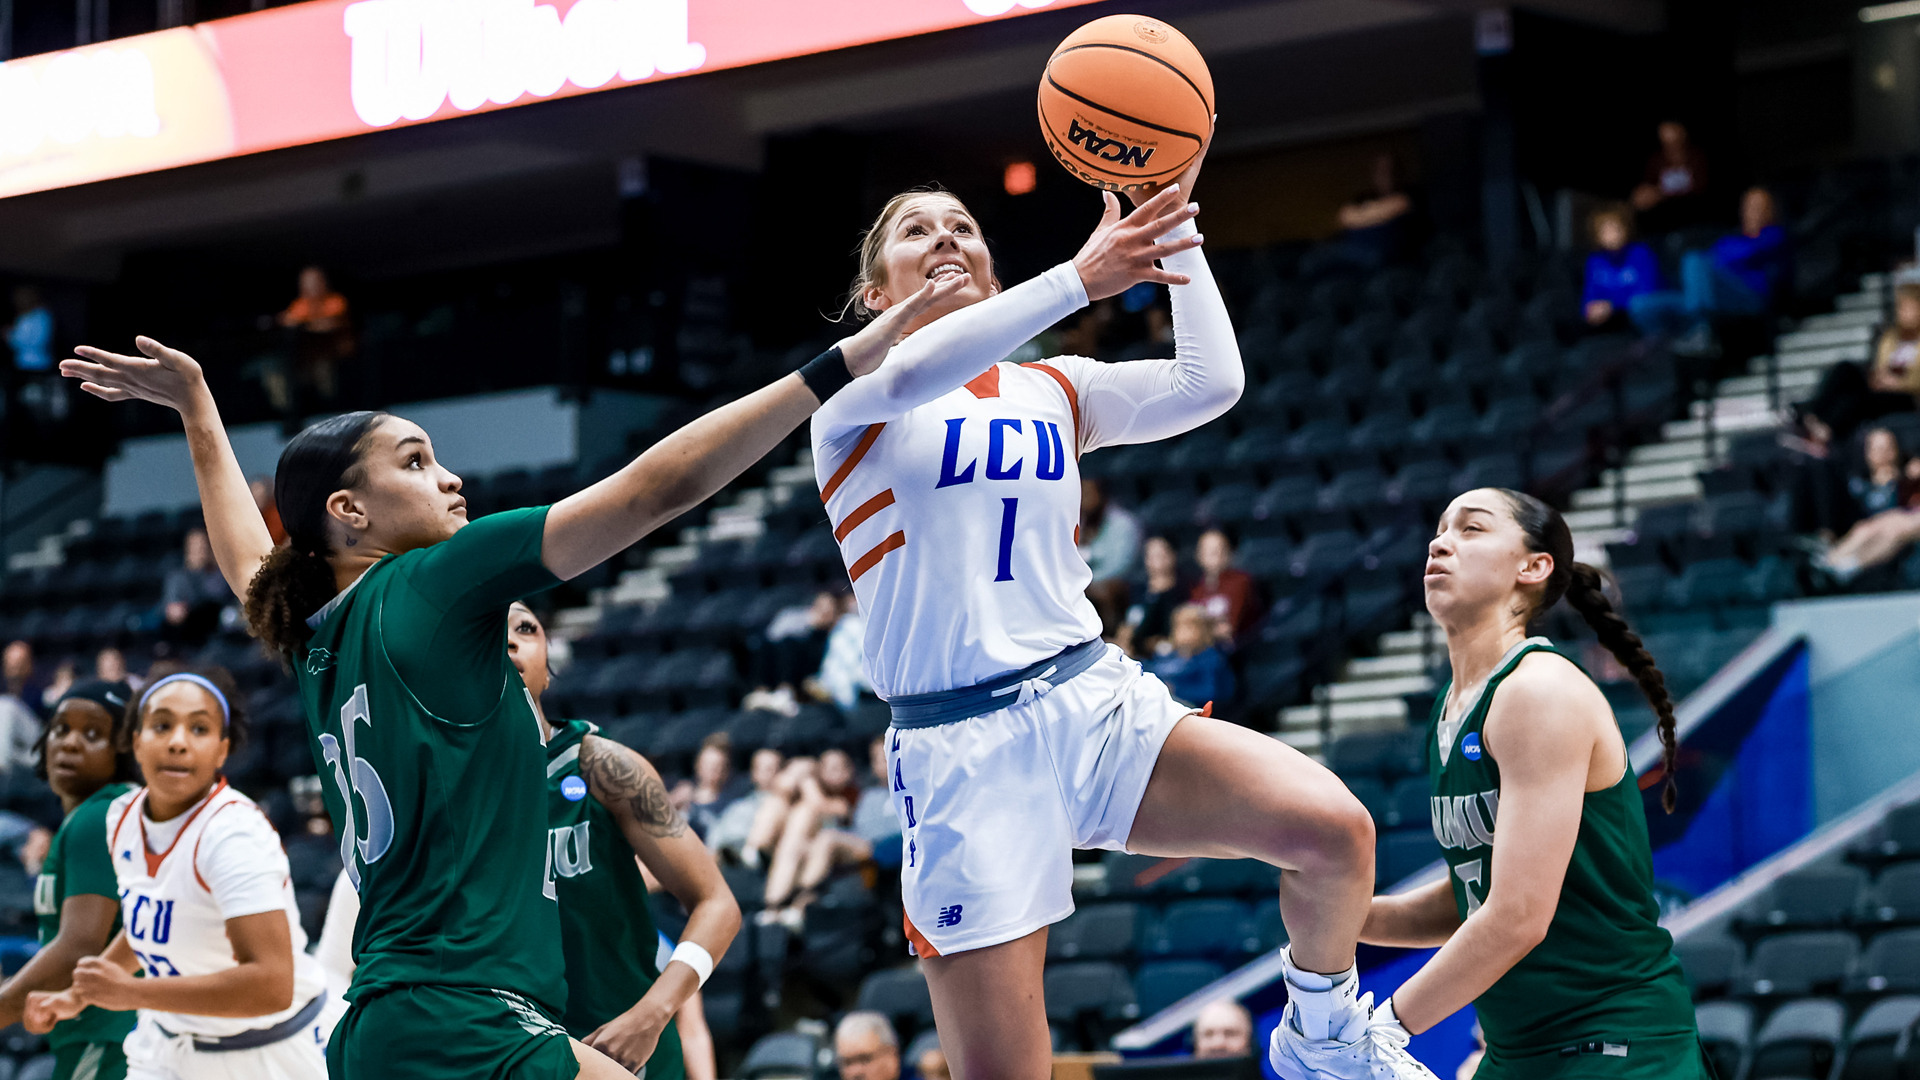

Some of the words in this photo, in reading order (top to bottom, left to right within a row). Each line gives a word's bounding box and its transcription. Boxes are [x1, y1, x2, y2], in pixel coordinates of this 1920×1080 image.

[1067, 118, 1156, 168] NCAA
[1075, 111, 1094, 128] BALL
[1121, 135, 1158, 146] OFFICIAL
[935, 417, 1065, 489] LCU
[993, 498, 1019, 582] 1
